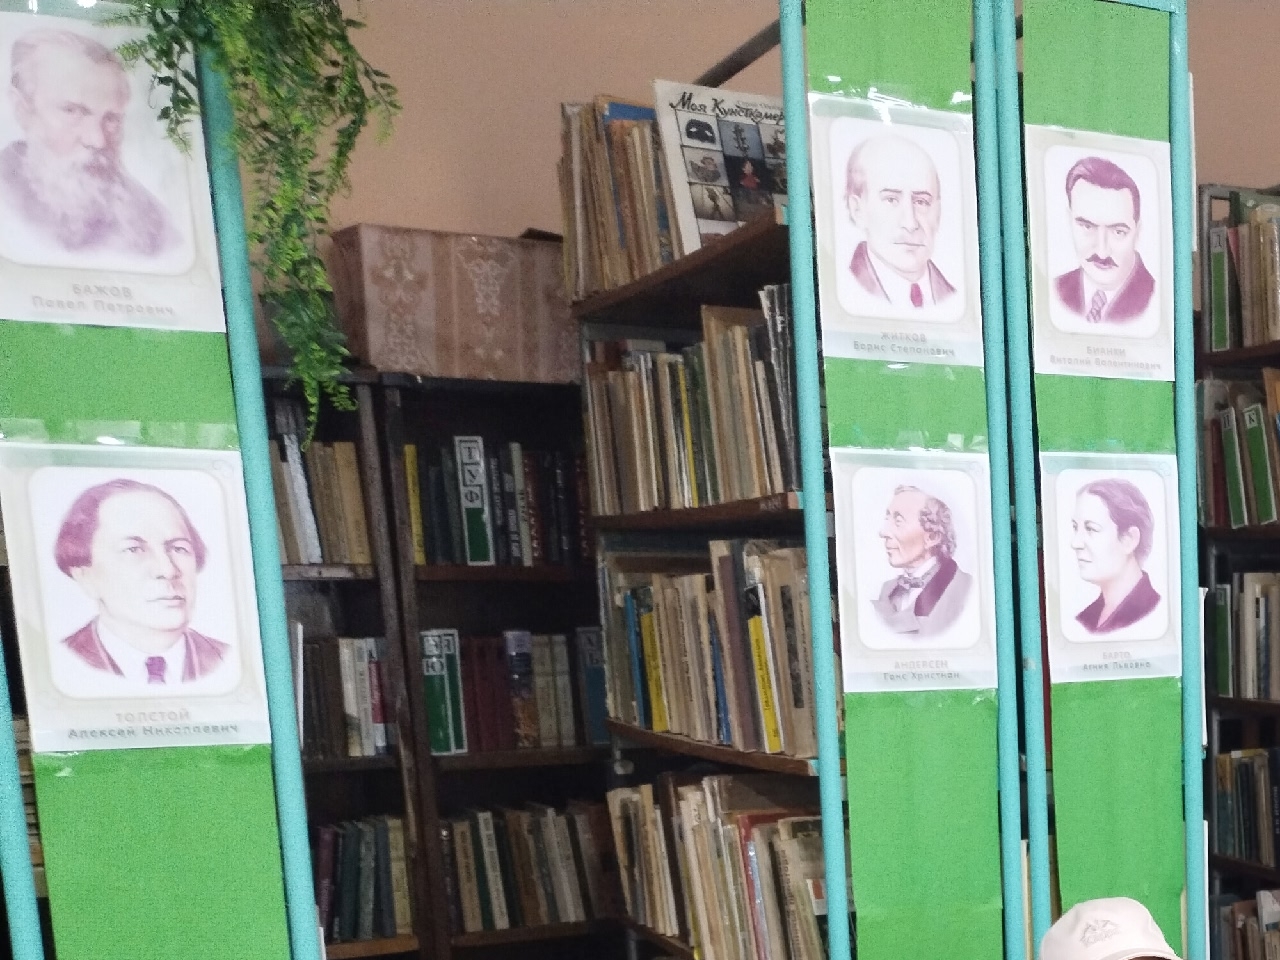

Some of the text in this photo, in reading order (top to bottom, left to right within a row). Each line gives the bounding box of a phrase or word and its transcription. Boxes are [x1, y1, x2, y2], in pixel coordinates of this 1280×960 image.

[669, 92, 708, 114] Моя
[711, 98, 785, 125] Кунсткамер
[73, 284, 132, 298] БАЖОВ
[32, 296, 174, 315] Павел Петрович
[881, 331, 927, 343] ЖИТКОВ
[853, 341, 955, 356] Борис Степанович
[1086, 346, 1126, 356] БИАНКИ
[1103, 651, 1131, 660] БАРТО
[894, 660, 949, 669] АНДЕРСЕН
[883, 671, 960, 681] Ганс Христиан
[115, 708, 190, 724] ТОЛСТОЙ
[68, 723, 238, 740] Алексей Николаевич
